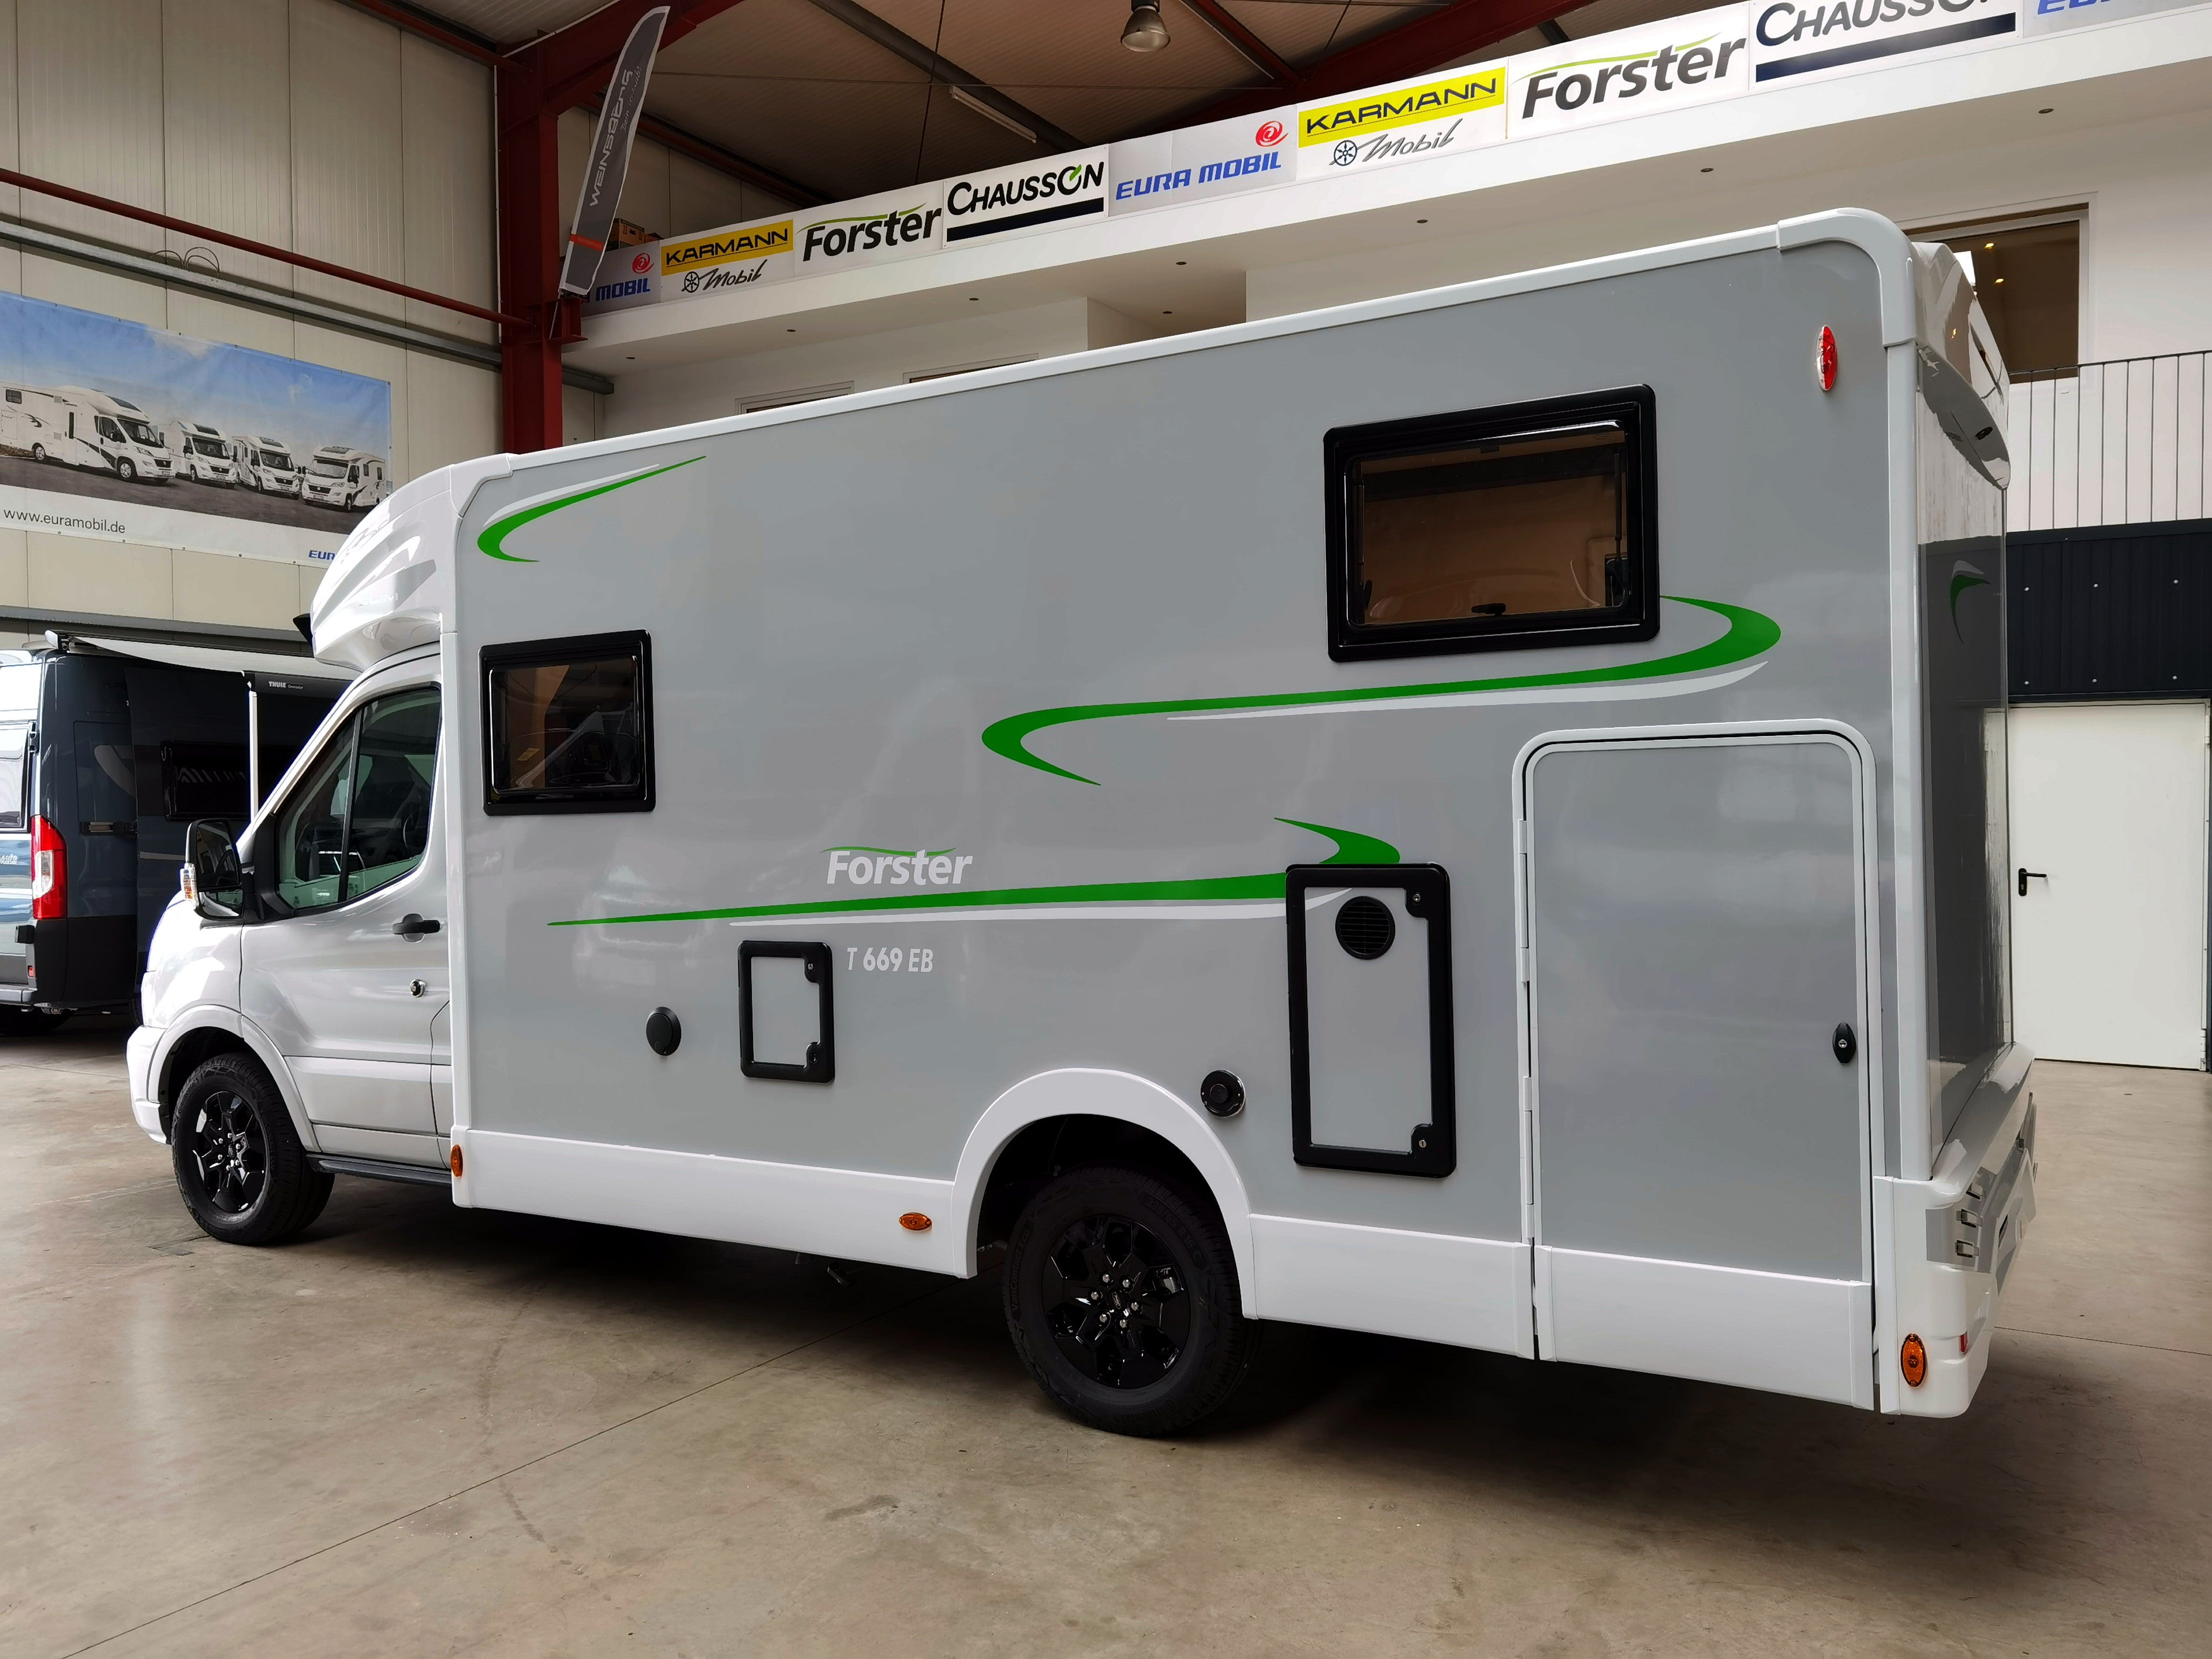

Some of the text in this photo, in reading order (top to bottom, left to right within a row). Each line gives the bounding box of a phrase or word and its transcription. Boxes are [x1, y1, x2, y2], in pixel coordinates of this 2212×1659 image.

[1522, 37, 1746, 120] Forster
[1307, 77, 1496, 134] KARMANN
[1357, 118, 1463, 163] Mobil
[947, 161, 1104, 215] CHAUSSON
[1116, 151, 1282, 200] EURA MOBIL
[666, 228, 788, 265] KARMANN
[803, 207, 942, 262] Forster
[596, 278, 651, 302] MOBIL
[700, 259, 768, 290] Mobil
[4, 509, 125, 534] www.euramobil.de
[308, 550, 337, 561] EUR
[826, 849, 973, 886] Forster
[847, 947, 934, 972] T 669 EB
